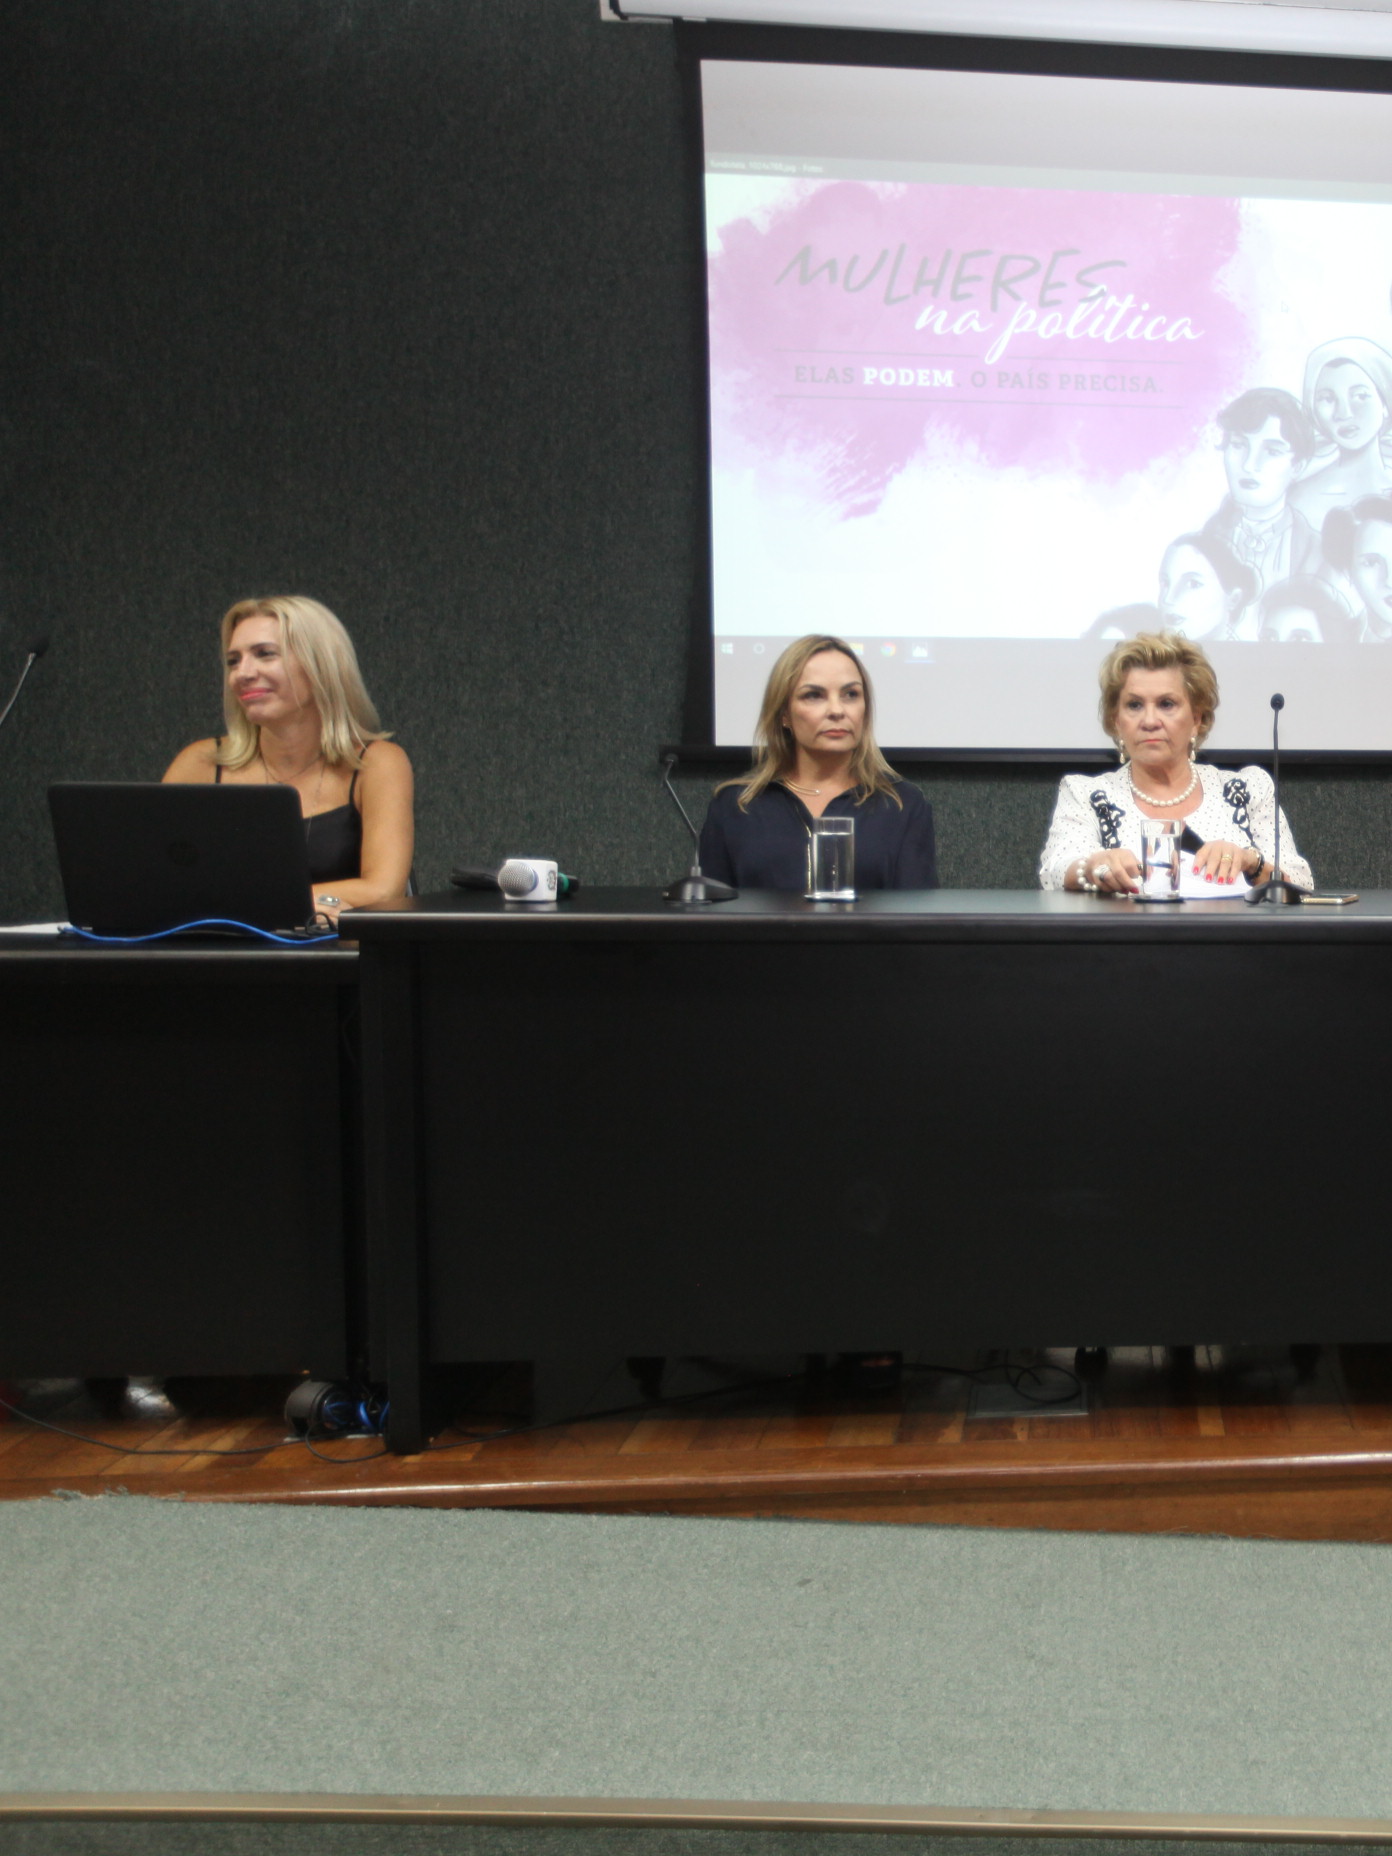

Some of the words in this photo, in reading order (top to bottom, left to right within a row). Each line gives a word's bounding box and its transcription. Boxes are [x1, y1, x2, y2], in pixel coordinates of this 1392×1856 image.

[773, 243, 1127, 312] MULHERES
[915, 304, 993, 335] na
[984, 284, 1205, 364] política
[794, 365, 855, 385] ELAS
[971, 370, 987, 388] O
[997, 367, 1049, 391] PAÍS
[1059, 373, 1164, 394] PRECISA.
